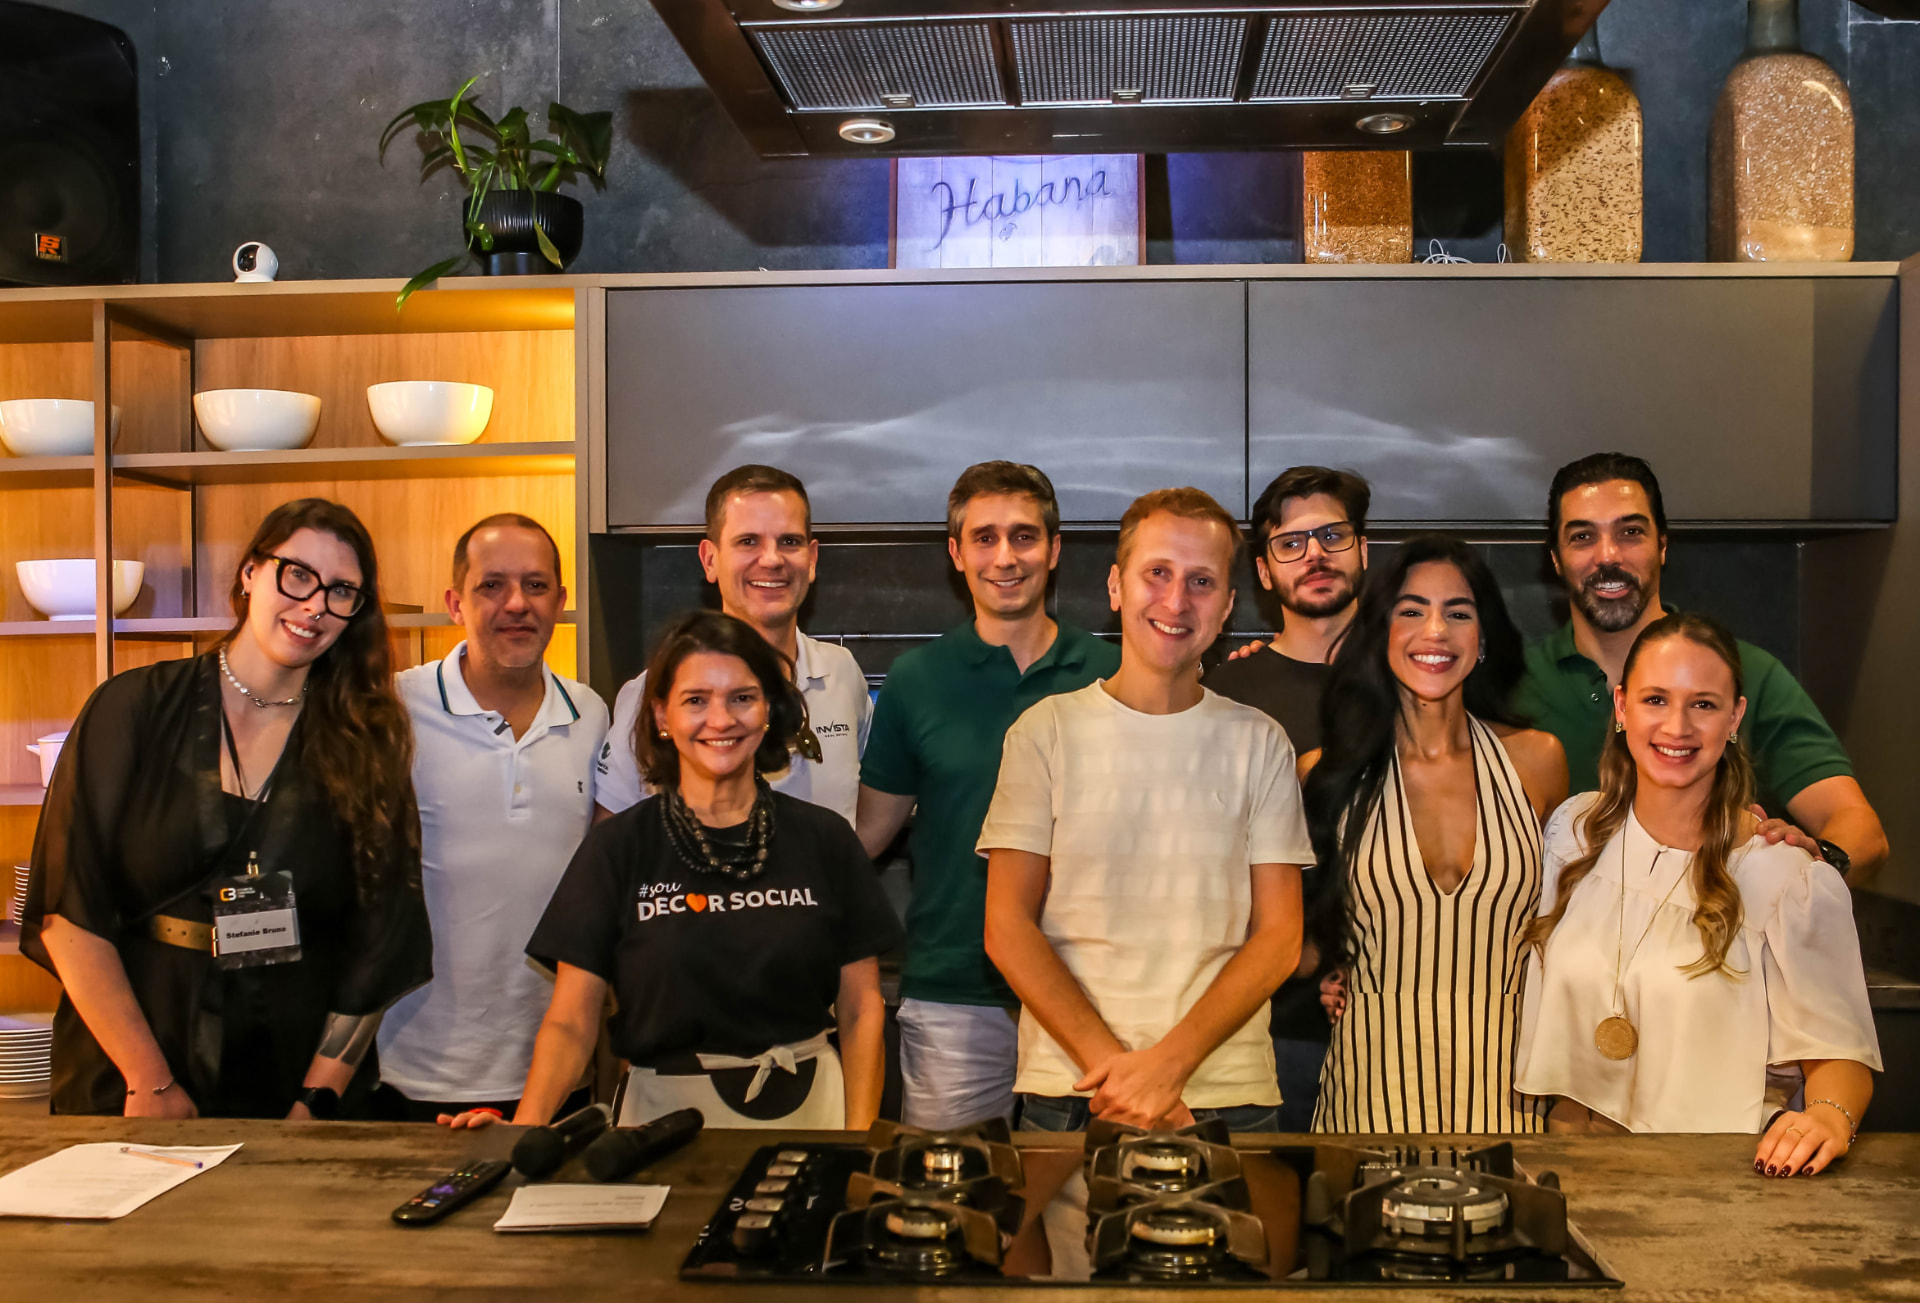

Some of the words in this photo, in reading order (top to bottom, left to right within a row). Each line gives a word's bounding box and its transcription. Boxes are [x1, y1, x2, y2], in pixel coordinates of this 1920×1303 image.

[928, 169, 1112, 251] Habana
[638, 881, 682, 897] #sou
[730, 888, 818, 911] SOCIAL
[226, 929, 260, 939] Stefanie
[262, 926, 287, 935] Bruno
